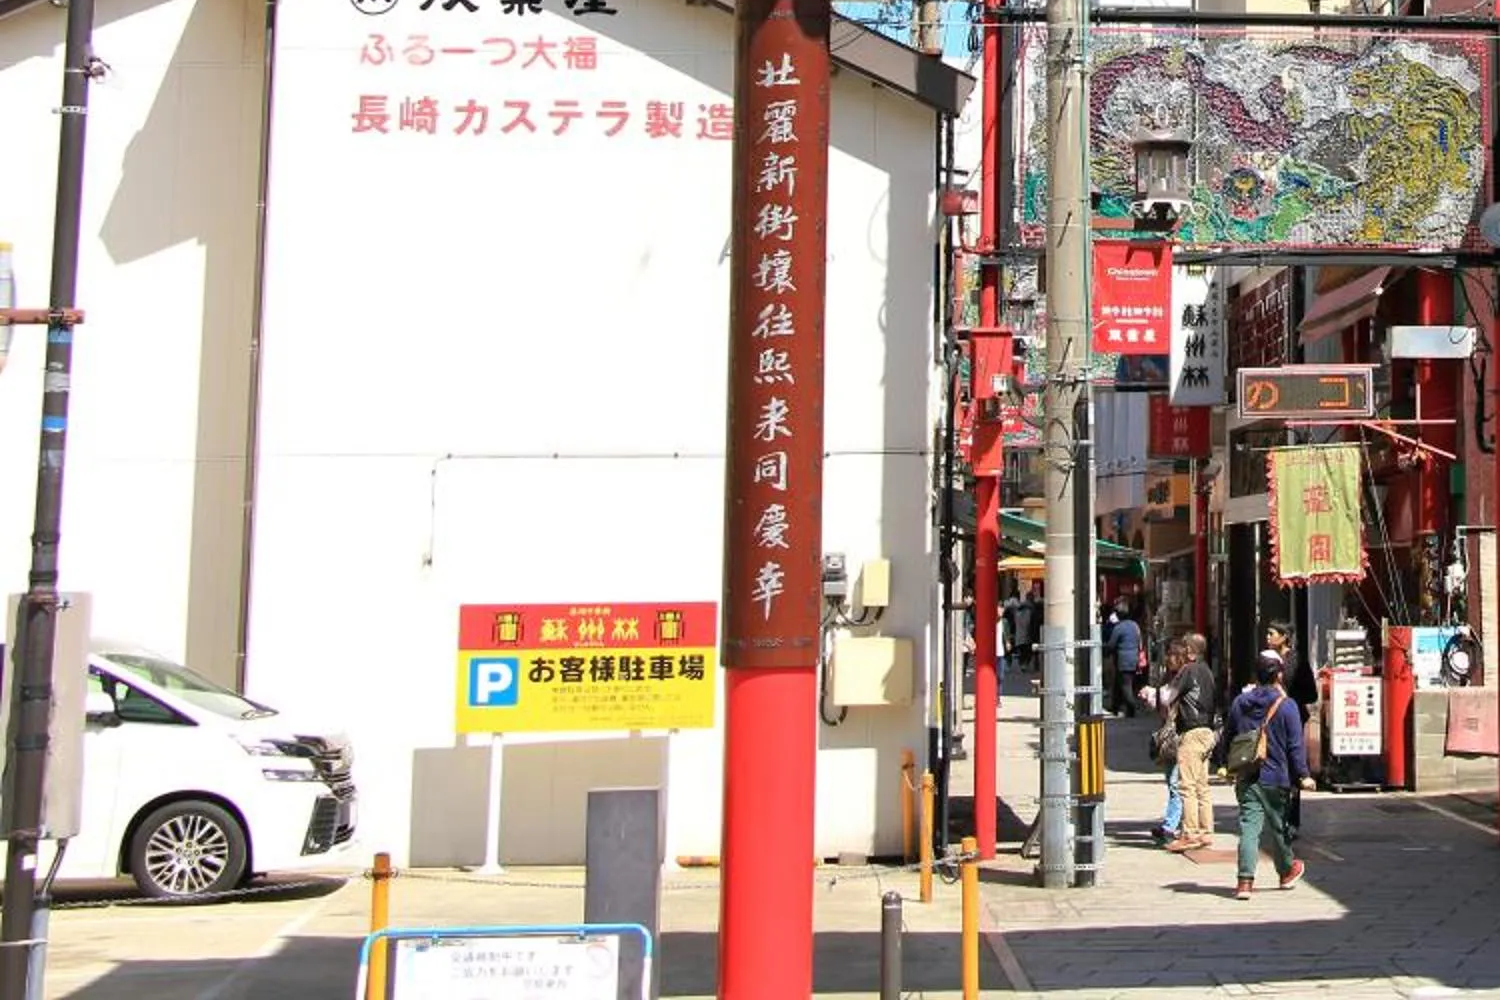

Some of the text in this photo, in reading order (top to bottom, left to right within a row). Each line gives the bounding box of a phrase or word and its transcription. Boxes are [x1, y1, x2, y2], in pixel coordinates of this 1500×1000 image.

[351, 94, 735, 142] 長崎カステラ製造
[476, 662, 513, 704] P
[527, 653, 706, 684] お客様駐車場
